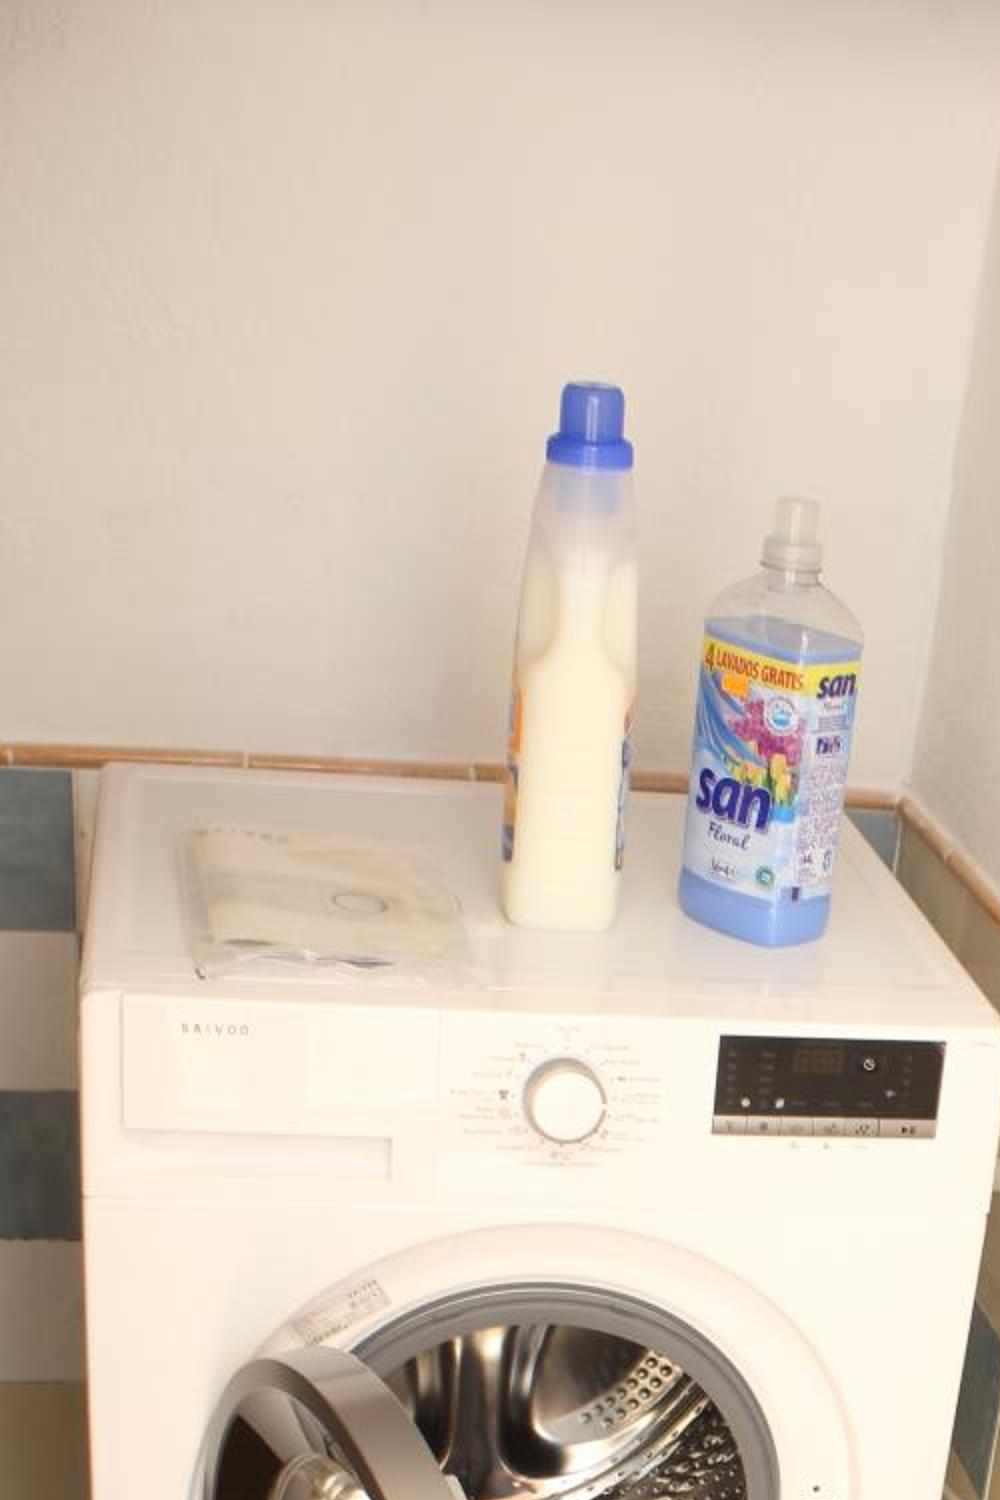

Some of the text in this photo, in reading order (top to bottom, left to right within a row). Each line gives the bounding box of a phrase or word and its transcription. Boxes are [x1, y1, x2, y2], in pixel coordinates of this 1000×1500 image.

[704, 645, 804, 690] 4 LAVADOS GRATIS
[817, 673, 856, 698] san
[696, 767, 772, 834] san
[707, 822, 750, 850] Floral
